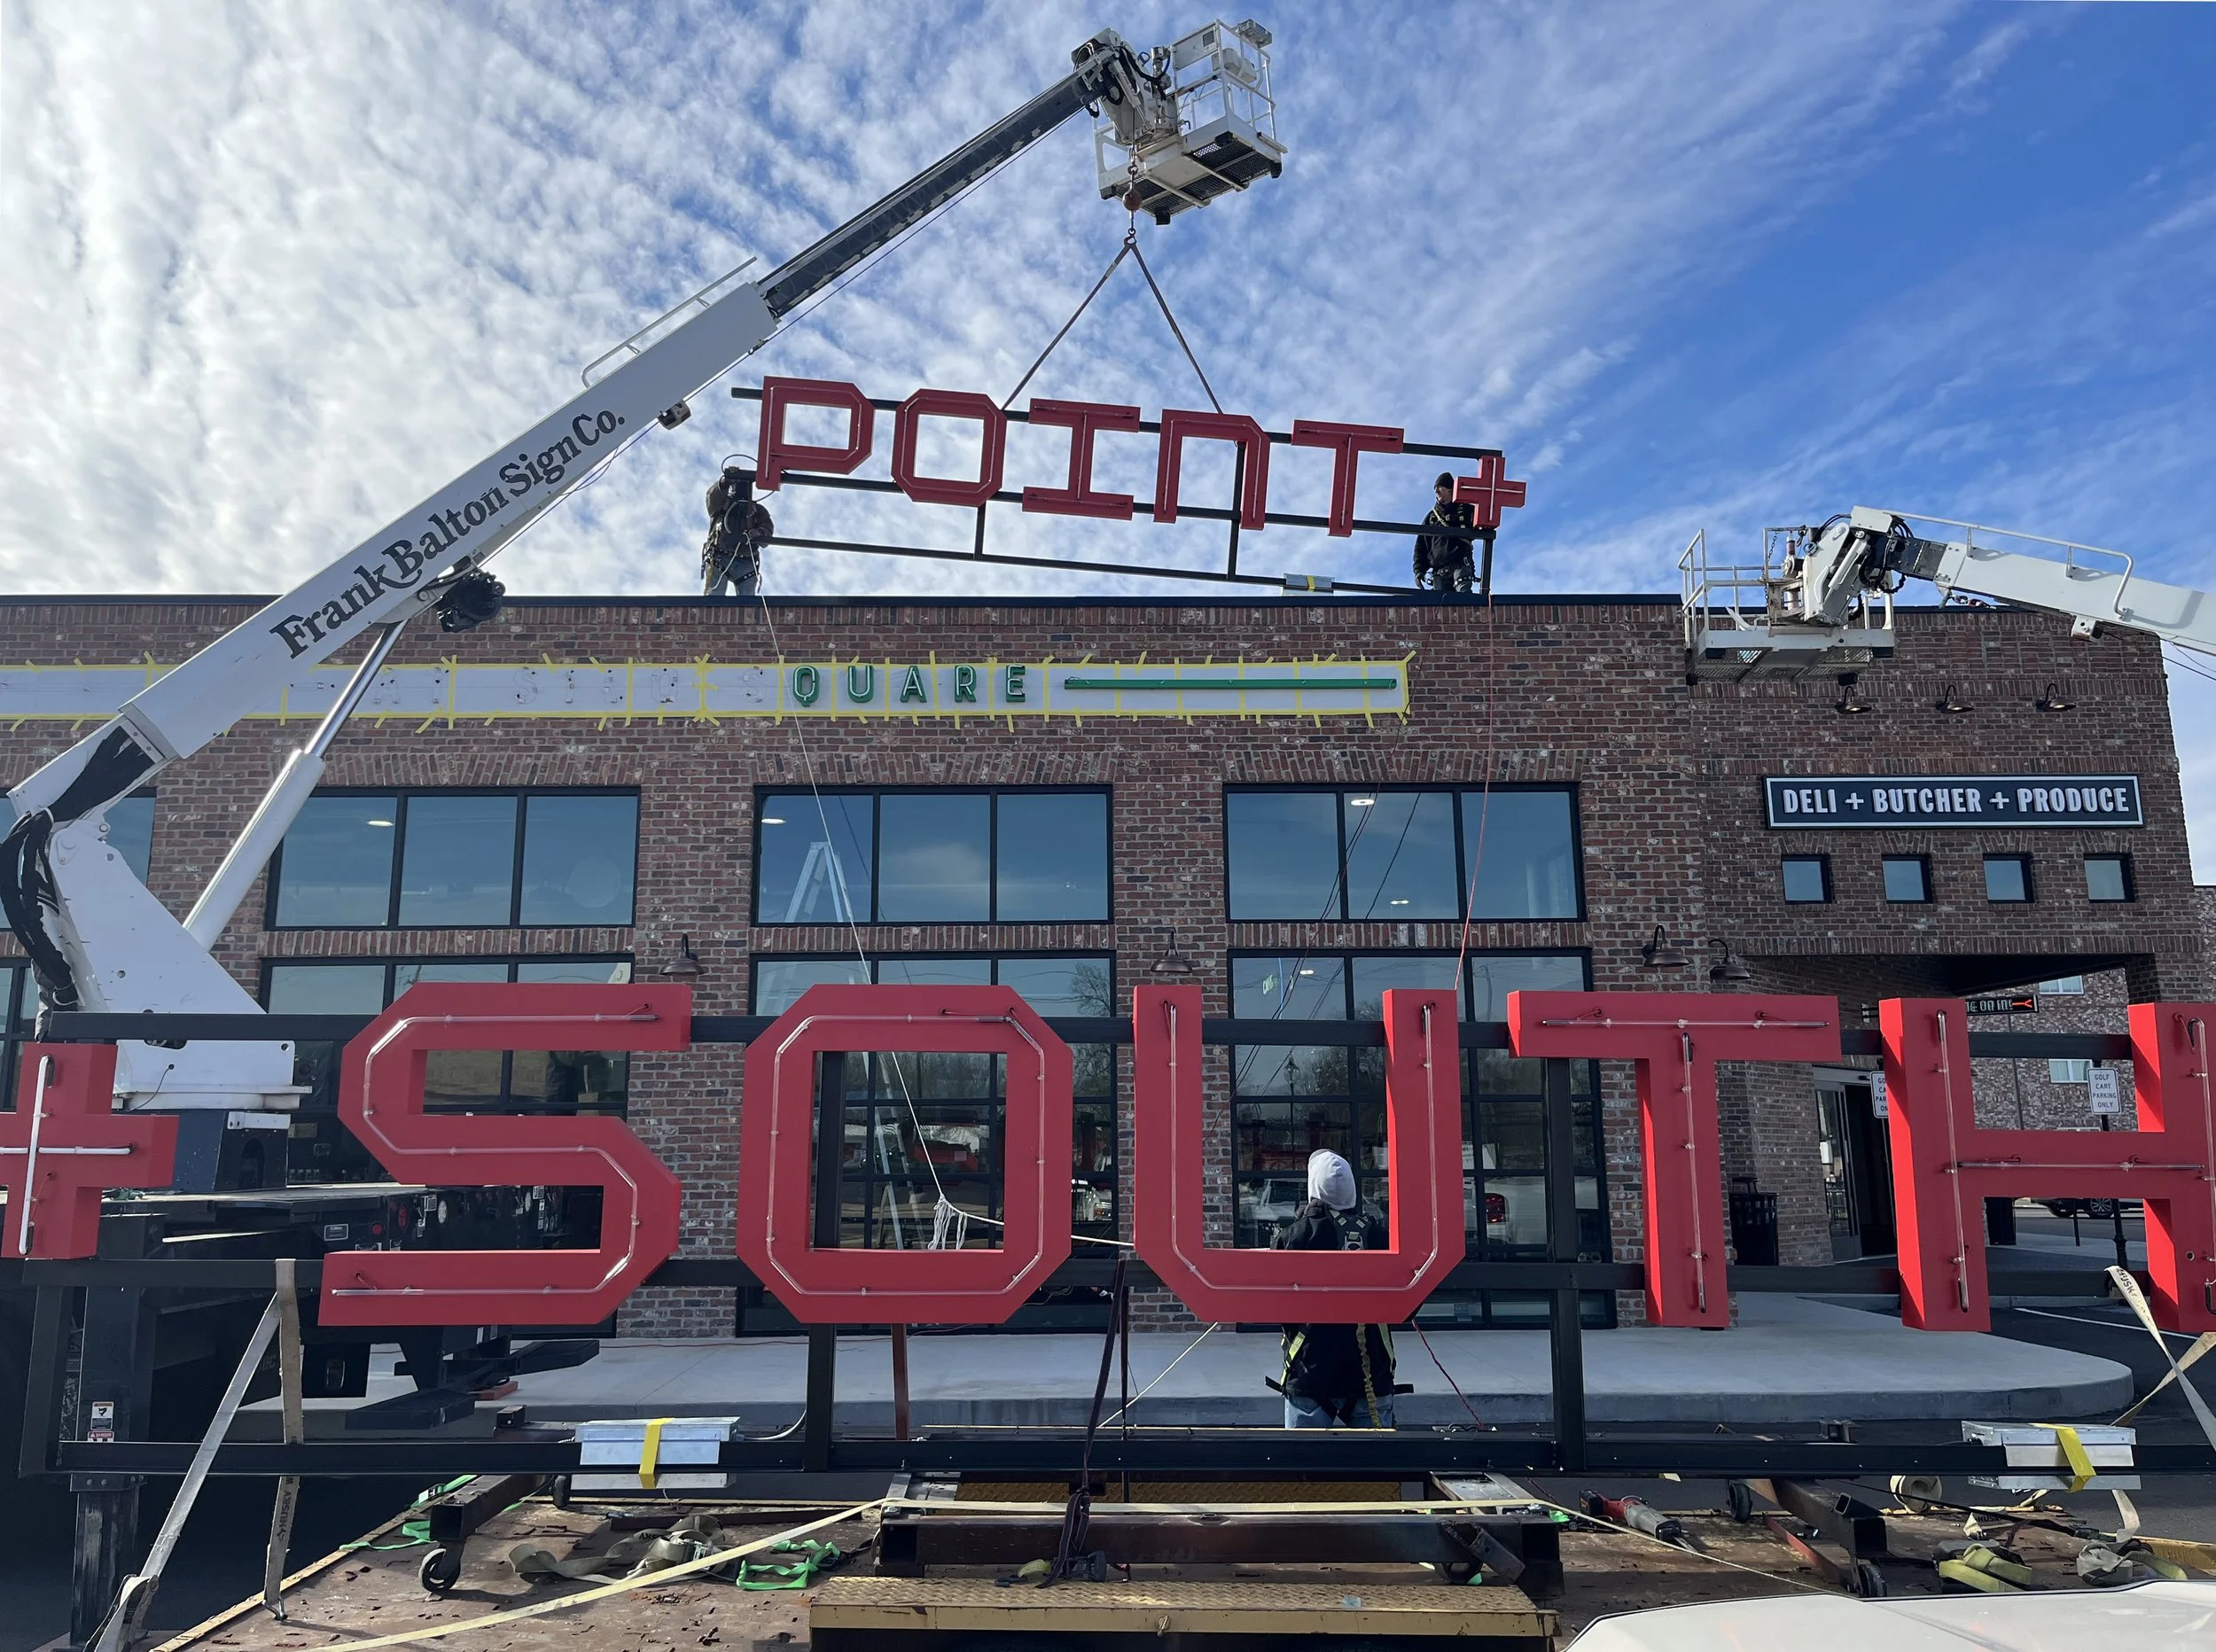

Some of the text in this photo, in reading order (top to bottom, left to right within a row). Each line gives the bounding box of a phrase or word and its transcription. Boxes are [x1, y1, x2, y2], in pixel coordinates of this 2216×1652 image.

[269, 408, 625, 660] Frank Balton Sign Co.
[755, 376, 1405, 537] POINT
[1783, 788, 1838, 814] DELI
[1873, 787, 1983, 814] BUTCHER
[2017, 786, 2130, 814] PRODUCE
[320, 982, 2216, 1333] SOUTH
